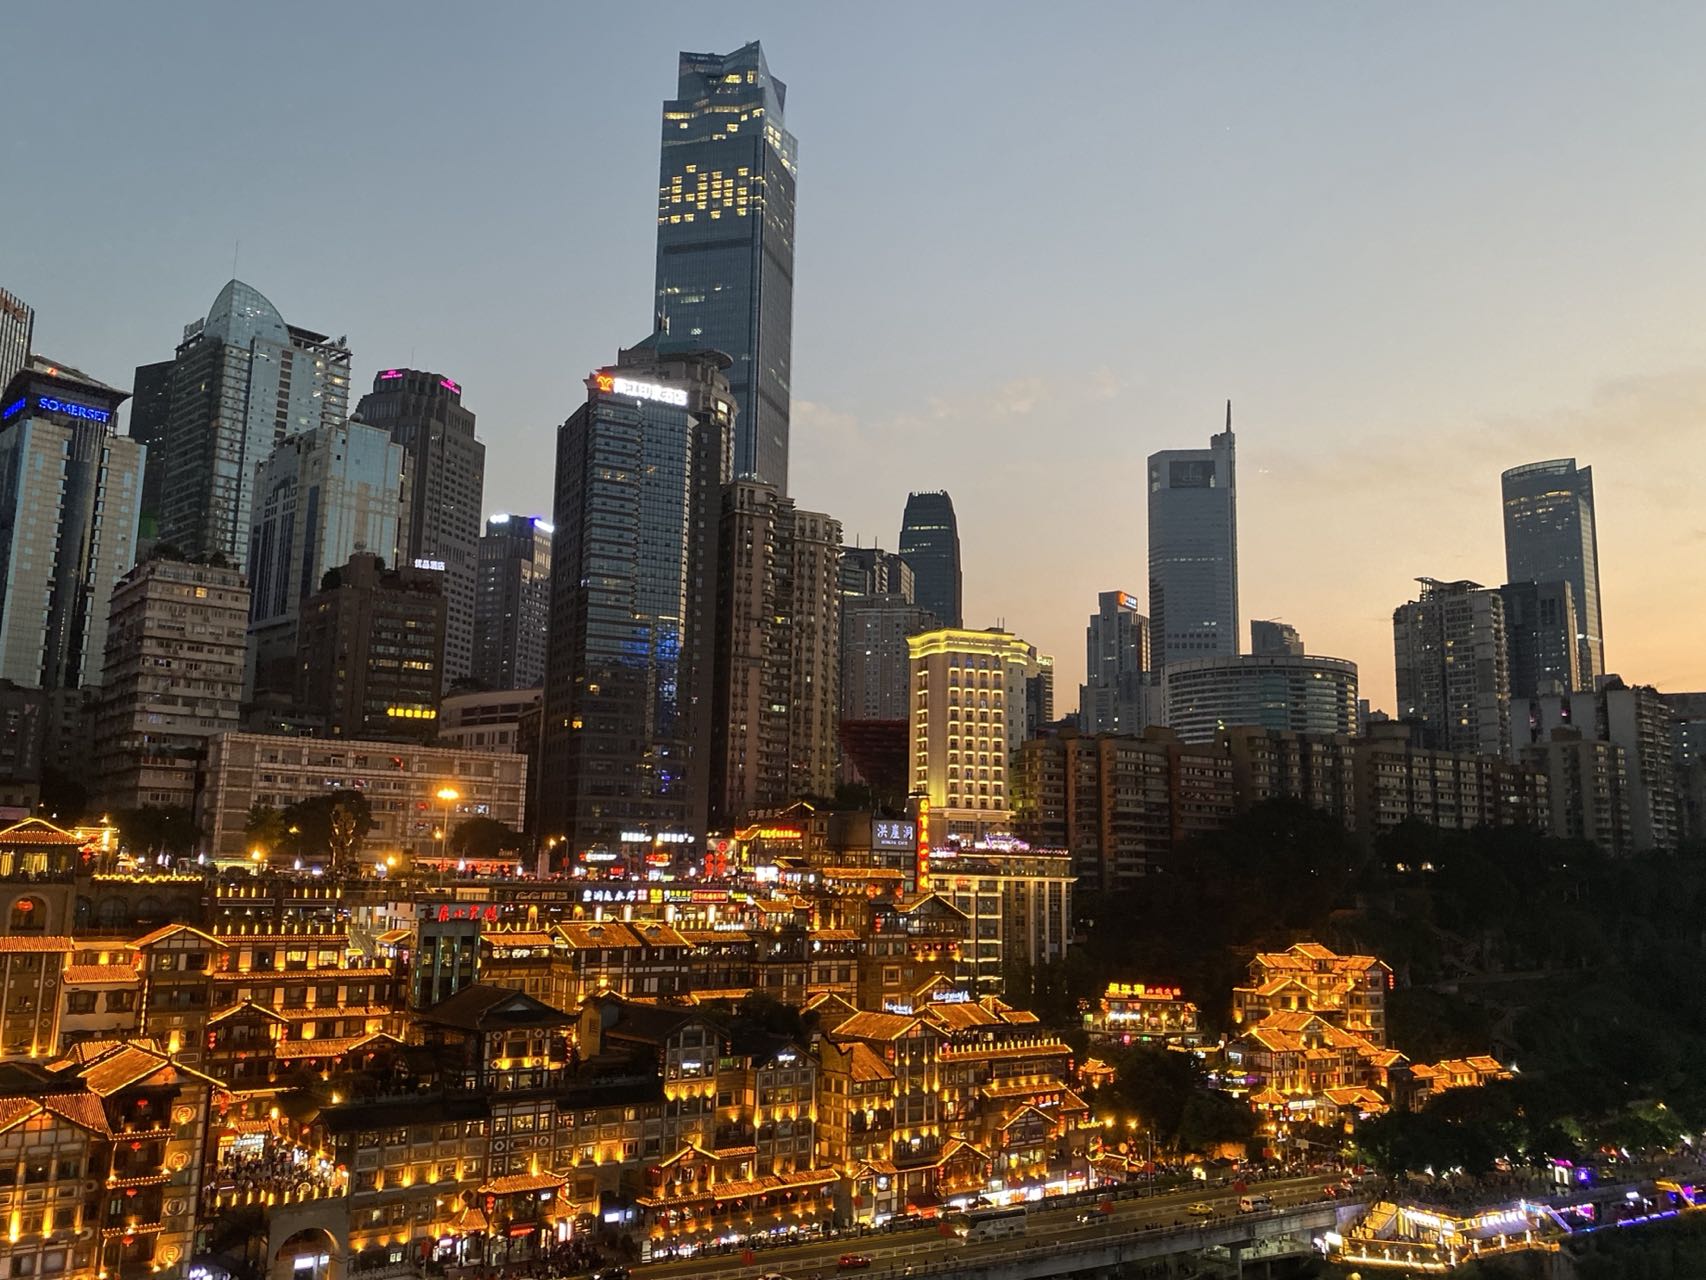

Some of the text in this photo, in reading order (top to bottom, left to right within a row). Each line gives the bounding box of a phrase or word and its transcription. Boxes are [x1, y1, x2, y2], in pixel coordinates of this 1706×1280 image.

[38, 397, 110, 422] SOMERSET
[877, 824, 913, 840] 洪崖洞
